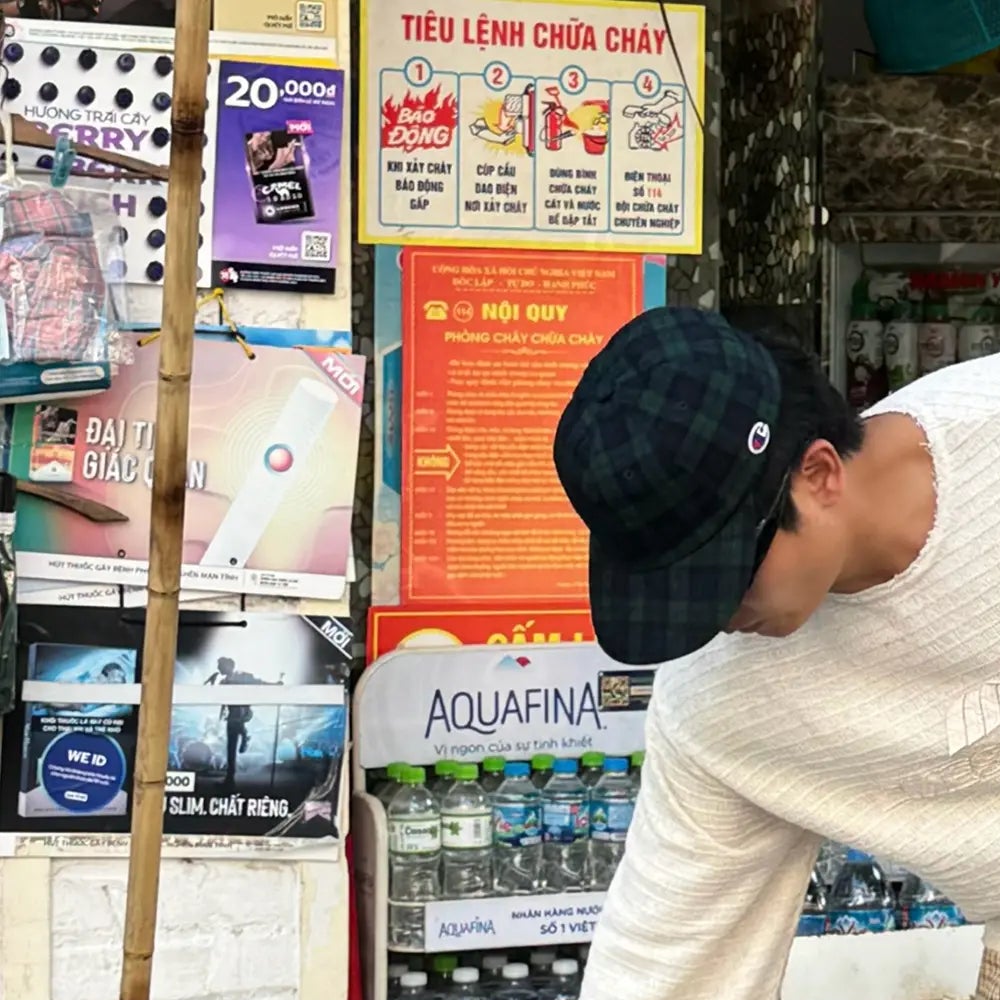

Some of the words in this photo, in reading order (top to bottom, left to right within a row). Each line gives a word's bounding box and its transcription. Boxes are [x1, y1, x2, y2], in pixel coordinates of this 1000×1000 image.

[401, 10, 454, 43] TIÊU
[463, 13, 524, 51] LỆNH
[533, 17, 597, 51] CHỮA
[606, 23, 666, 55] CHÁY
[415, 64, 424, 81] 1
[493, 68, 503, 85] 2
[569, 72, 578, 88] 3
[24, 105, 82, 121] HƯƠNG
[398, 105, 435, 124] BÁO
[388, 124, 450, 150] ĐỘNG
[482, 299, 520, 324] NỘI
[525, 303, 569, 323] QUY
[493, 330, 528, 344] CHÁY
[568, 332, 604, 345] CHÁY
[85, 417, 127, 452] ĐẠI
[83, 447, 137, 483] GIÁC
[320, 619, 351, 650] MỚI
[425, 682, 602, 739] AQUAFINA
[67, 749, 91, 765] WE
[92, 752, 107, 766] ID
[209, 793, 246, 816] CHẤT
[576, 903, 603, 917] NƯỚ
